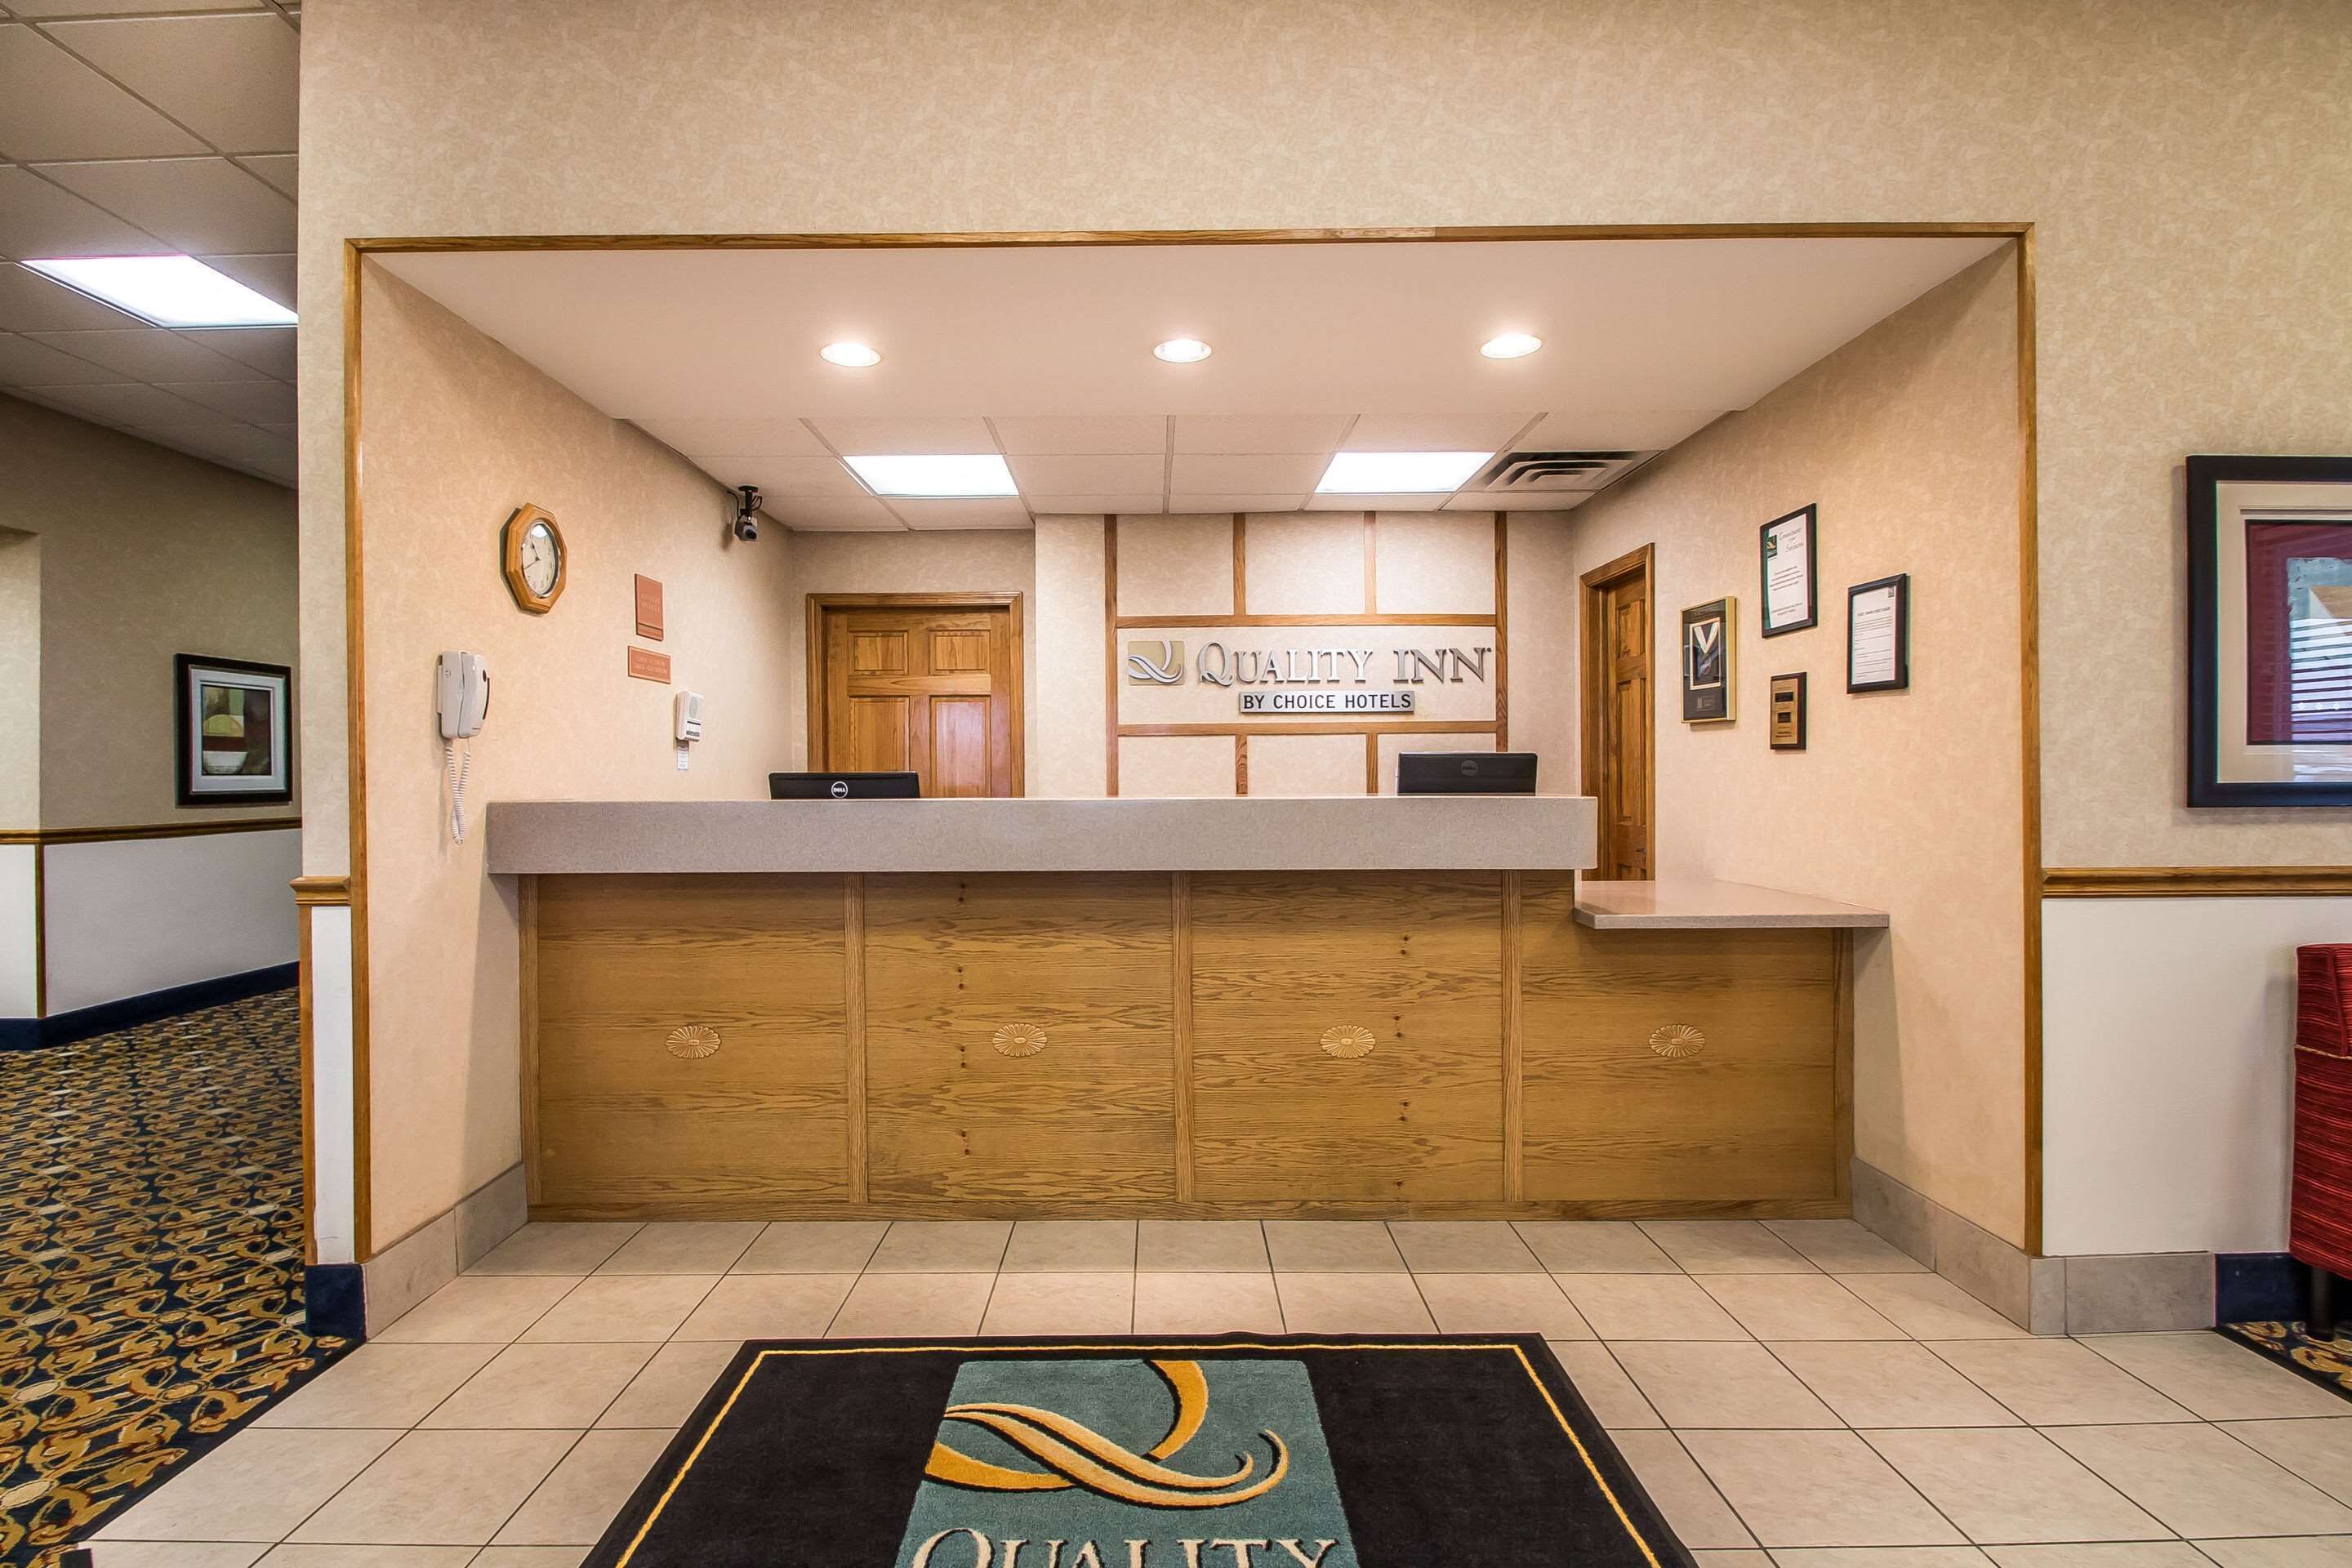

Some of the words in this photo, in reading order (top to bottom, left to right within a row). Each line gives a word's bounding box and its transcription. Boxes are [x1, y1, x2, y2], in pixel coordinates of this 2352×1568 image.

[1196, 641, 1373, 687] QUALITY
[1392, 647, 1486, 684] INN
[1243, 695, 1265, 709] BY
[1273, 695, 1336, 709] CHOICE
[1345, 694, 1411, 708] HOTELS
